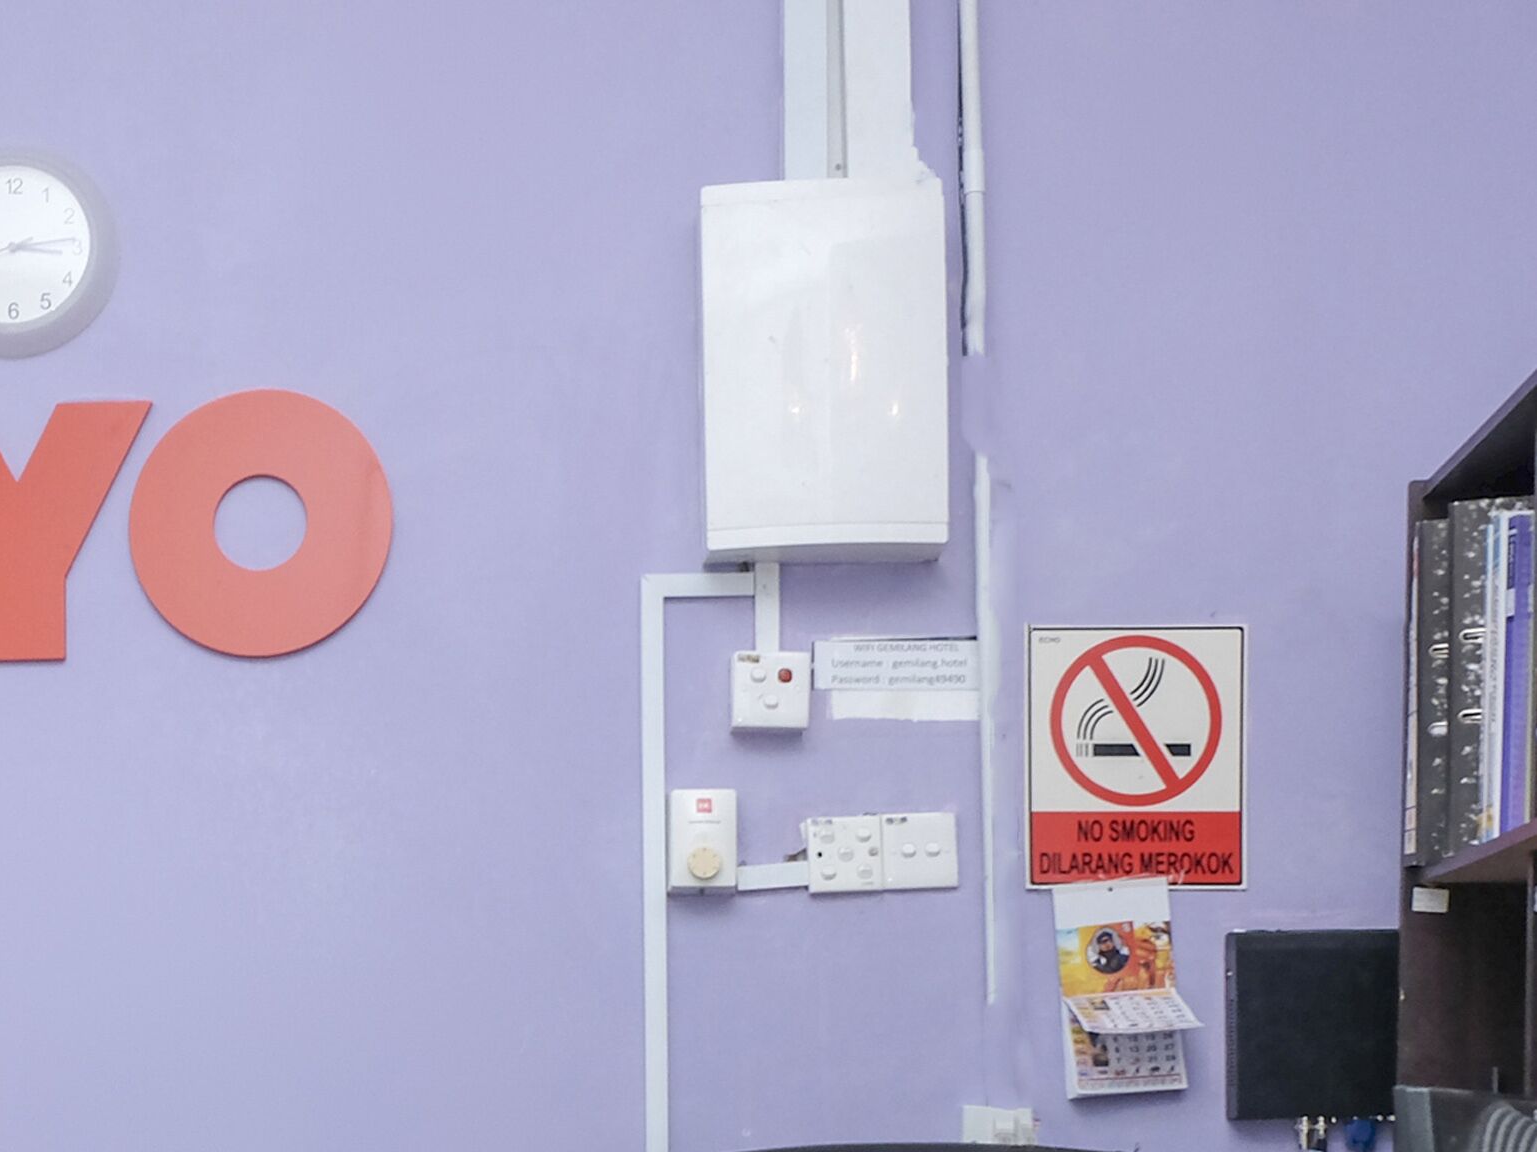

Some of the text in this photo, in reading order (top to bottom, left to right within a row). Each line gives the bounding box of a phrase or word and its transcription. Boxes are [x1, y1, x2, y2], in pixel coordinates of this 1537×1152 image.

[5, 177, 24, 195] 12
[63, 207, 76, 225] 2
[62, 271, 73, 287] 4
[39, 292, 52, 310] 5
[7, 302, 20, 320] 6
[929, 643, 959, 652] HOTEL
[831, 657, 884, 668] Username
[831, 674, 880, 684] Password
[1076, 819, 1195, 843] NO SMOKING
[1039, 852, 1234, 875] DILARANG MEROKOK
